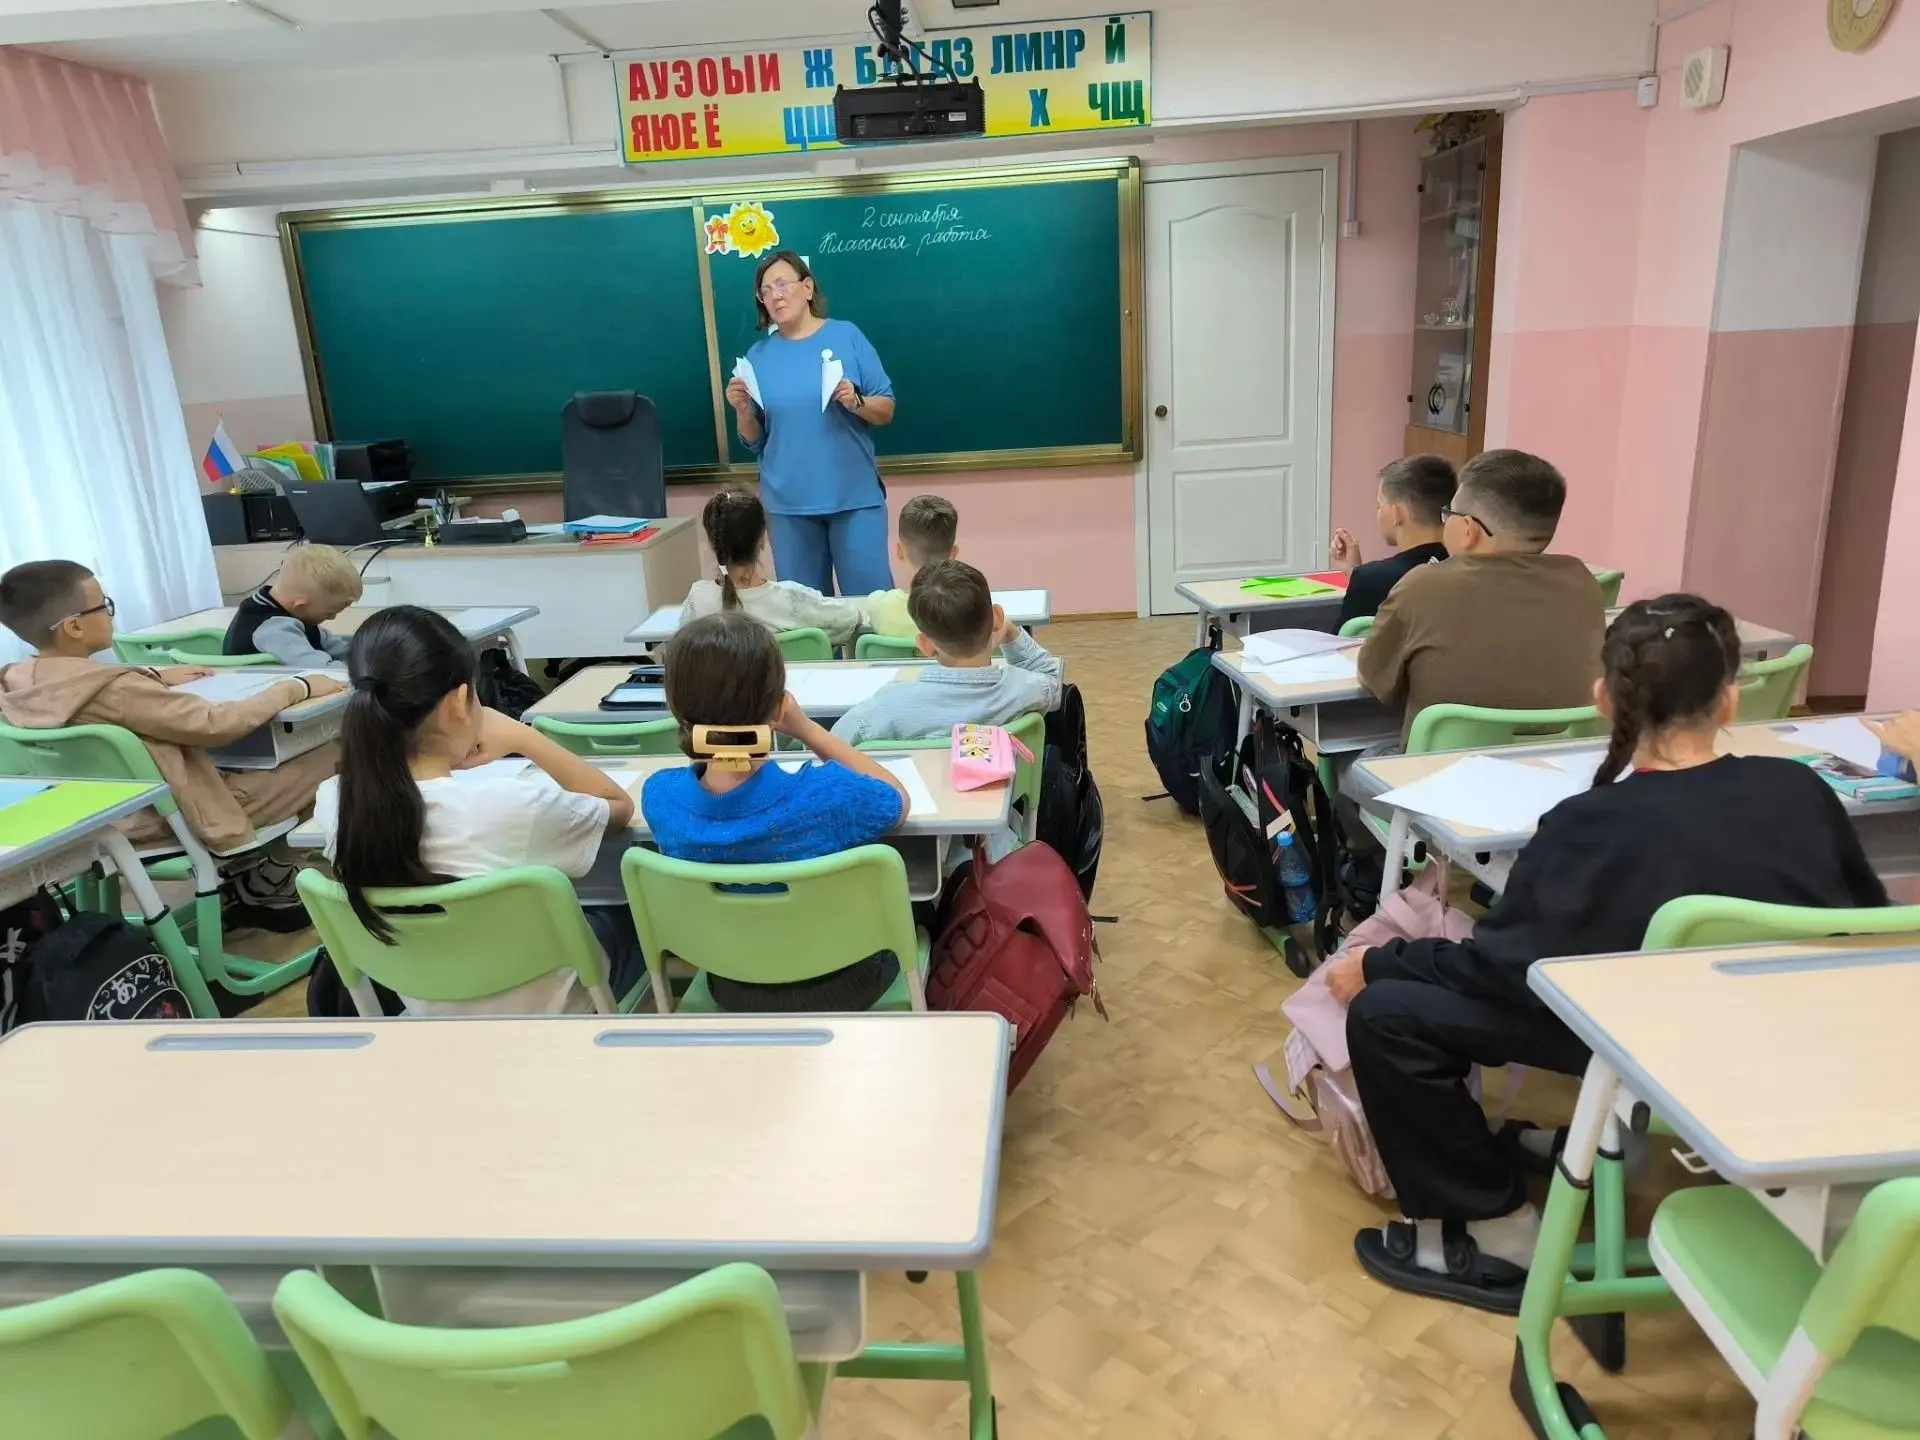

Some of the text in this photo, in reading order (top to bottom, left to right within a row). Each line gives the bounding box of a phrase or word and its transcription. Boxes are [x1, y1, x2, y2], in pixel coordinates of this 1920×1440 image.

[629, 53, 780, 101] АУЭОЫИ
[803, 49, 834, 88] Ж
[991, 29, 1085, 74] ЛМНР
[1105, 17, 1125, 64] Й
[1029, 89, 1050, 126] Х
[1088, 80, 1145, 124] ЧЩ
[862, 202, 964, 230] 2 сентября
[818, 226, 994, 256] Классная работа
